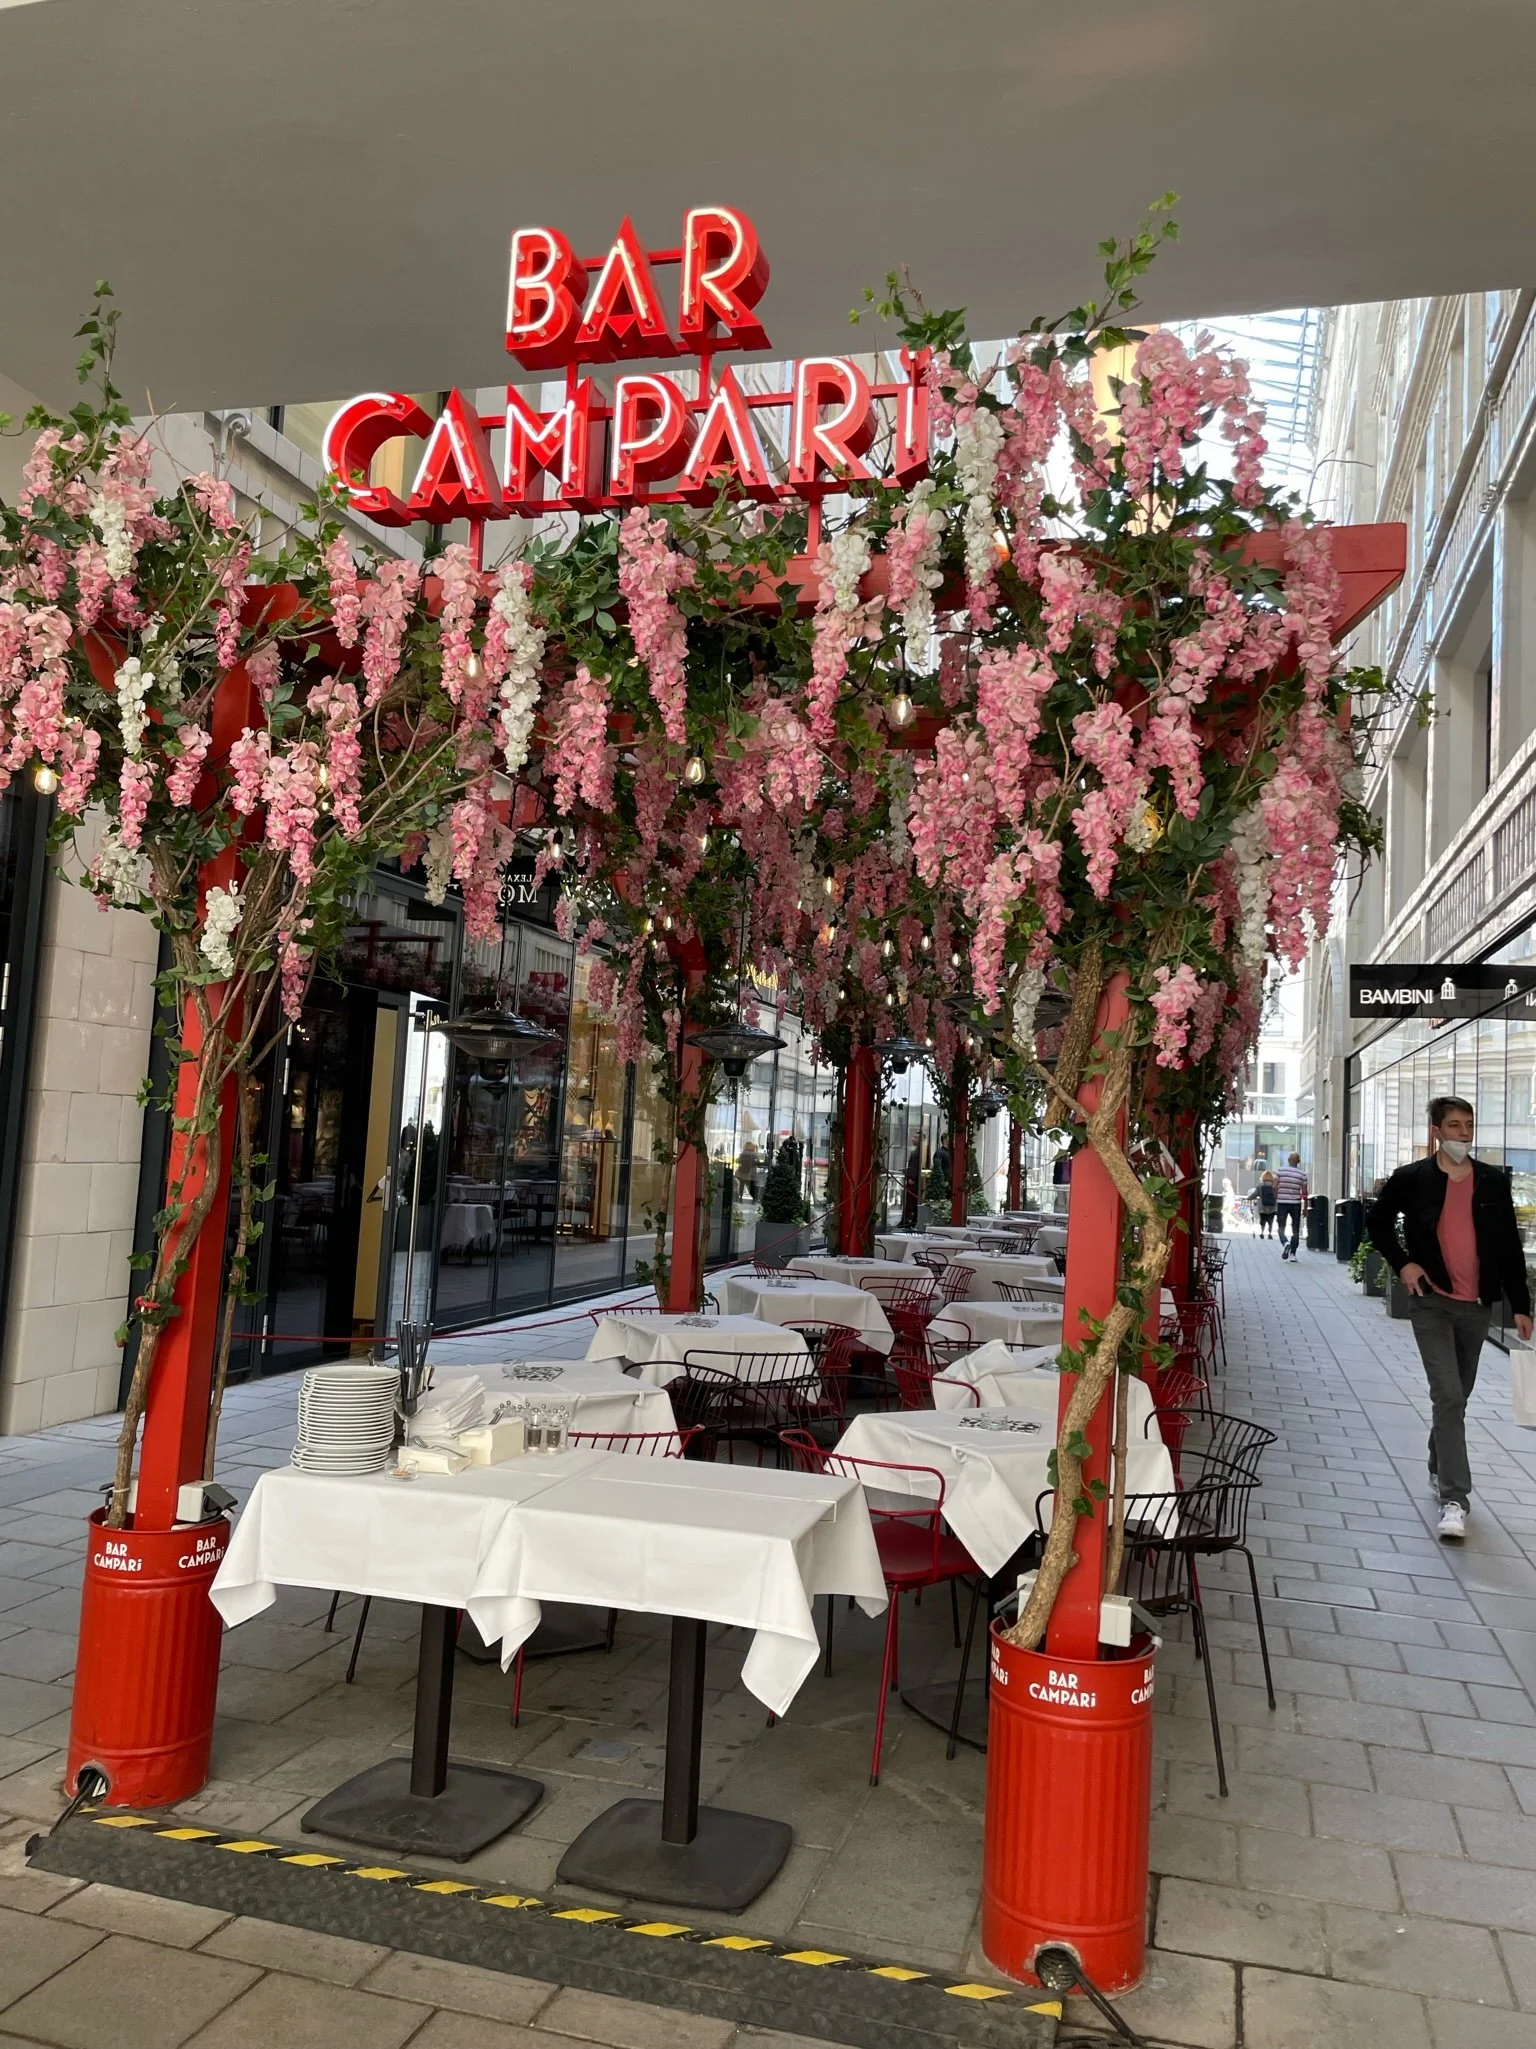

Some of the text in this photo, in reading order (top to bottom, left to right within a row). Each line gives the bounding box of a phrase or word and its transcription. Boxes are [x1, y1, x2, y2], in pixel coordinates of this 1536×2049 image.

[506, 206, 772, 370] BAR
[1359, 989, 1433, 1004] BAMBINI
[105, 1542, 128, 1557] BAR
[196, 1537, 216, 1552] BAR
[1049, 1670, 1078, 1690] BAR
